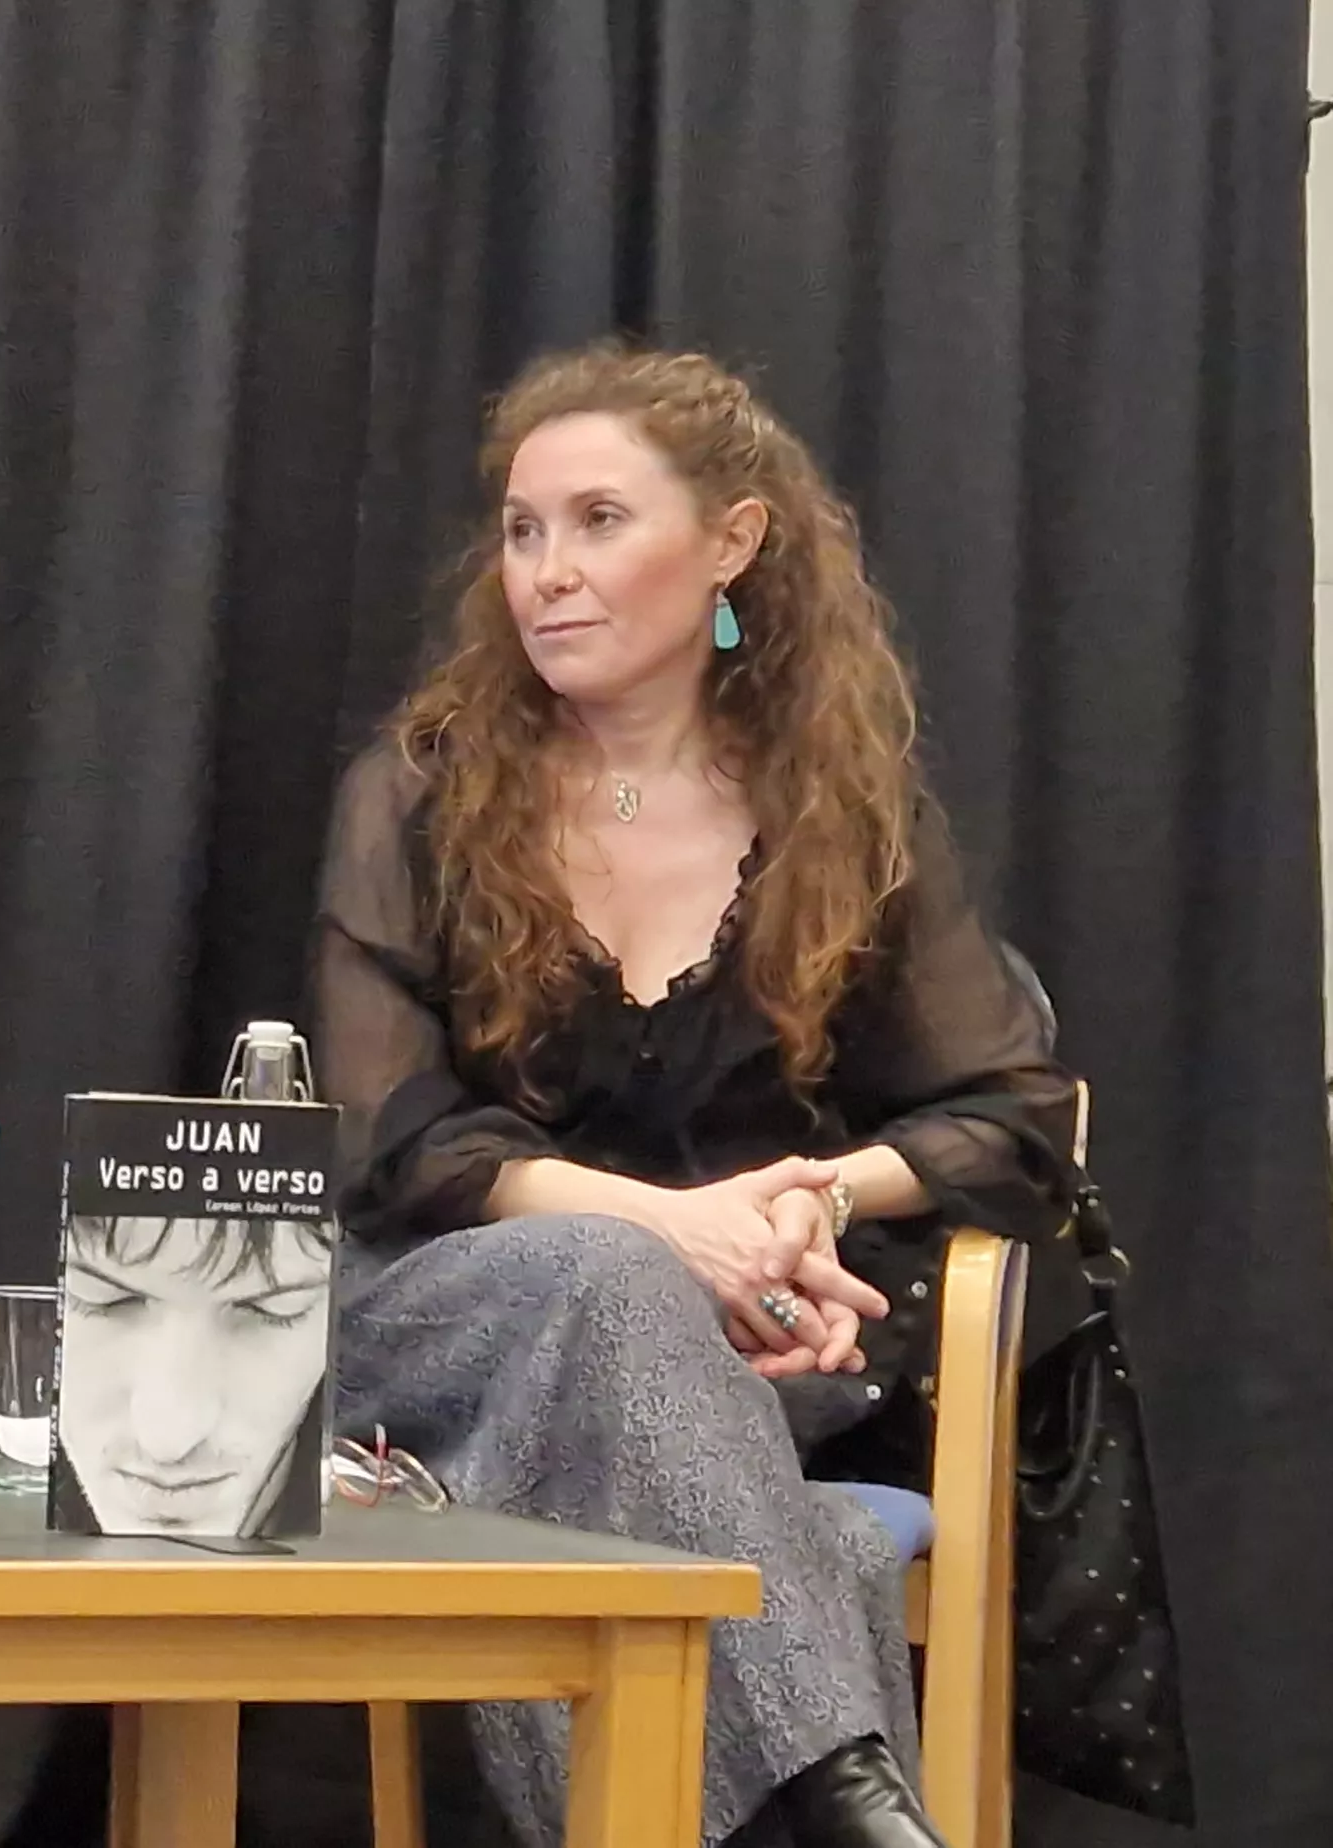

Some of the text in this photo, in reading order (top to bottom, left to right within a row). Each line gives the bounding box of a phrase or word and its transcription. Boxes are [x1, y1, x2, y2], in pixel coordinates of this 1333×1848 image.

[166, 1120, 261, 1153] JUAN
[99, 1157, 325, 1195] Verso a verso
